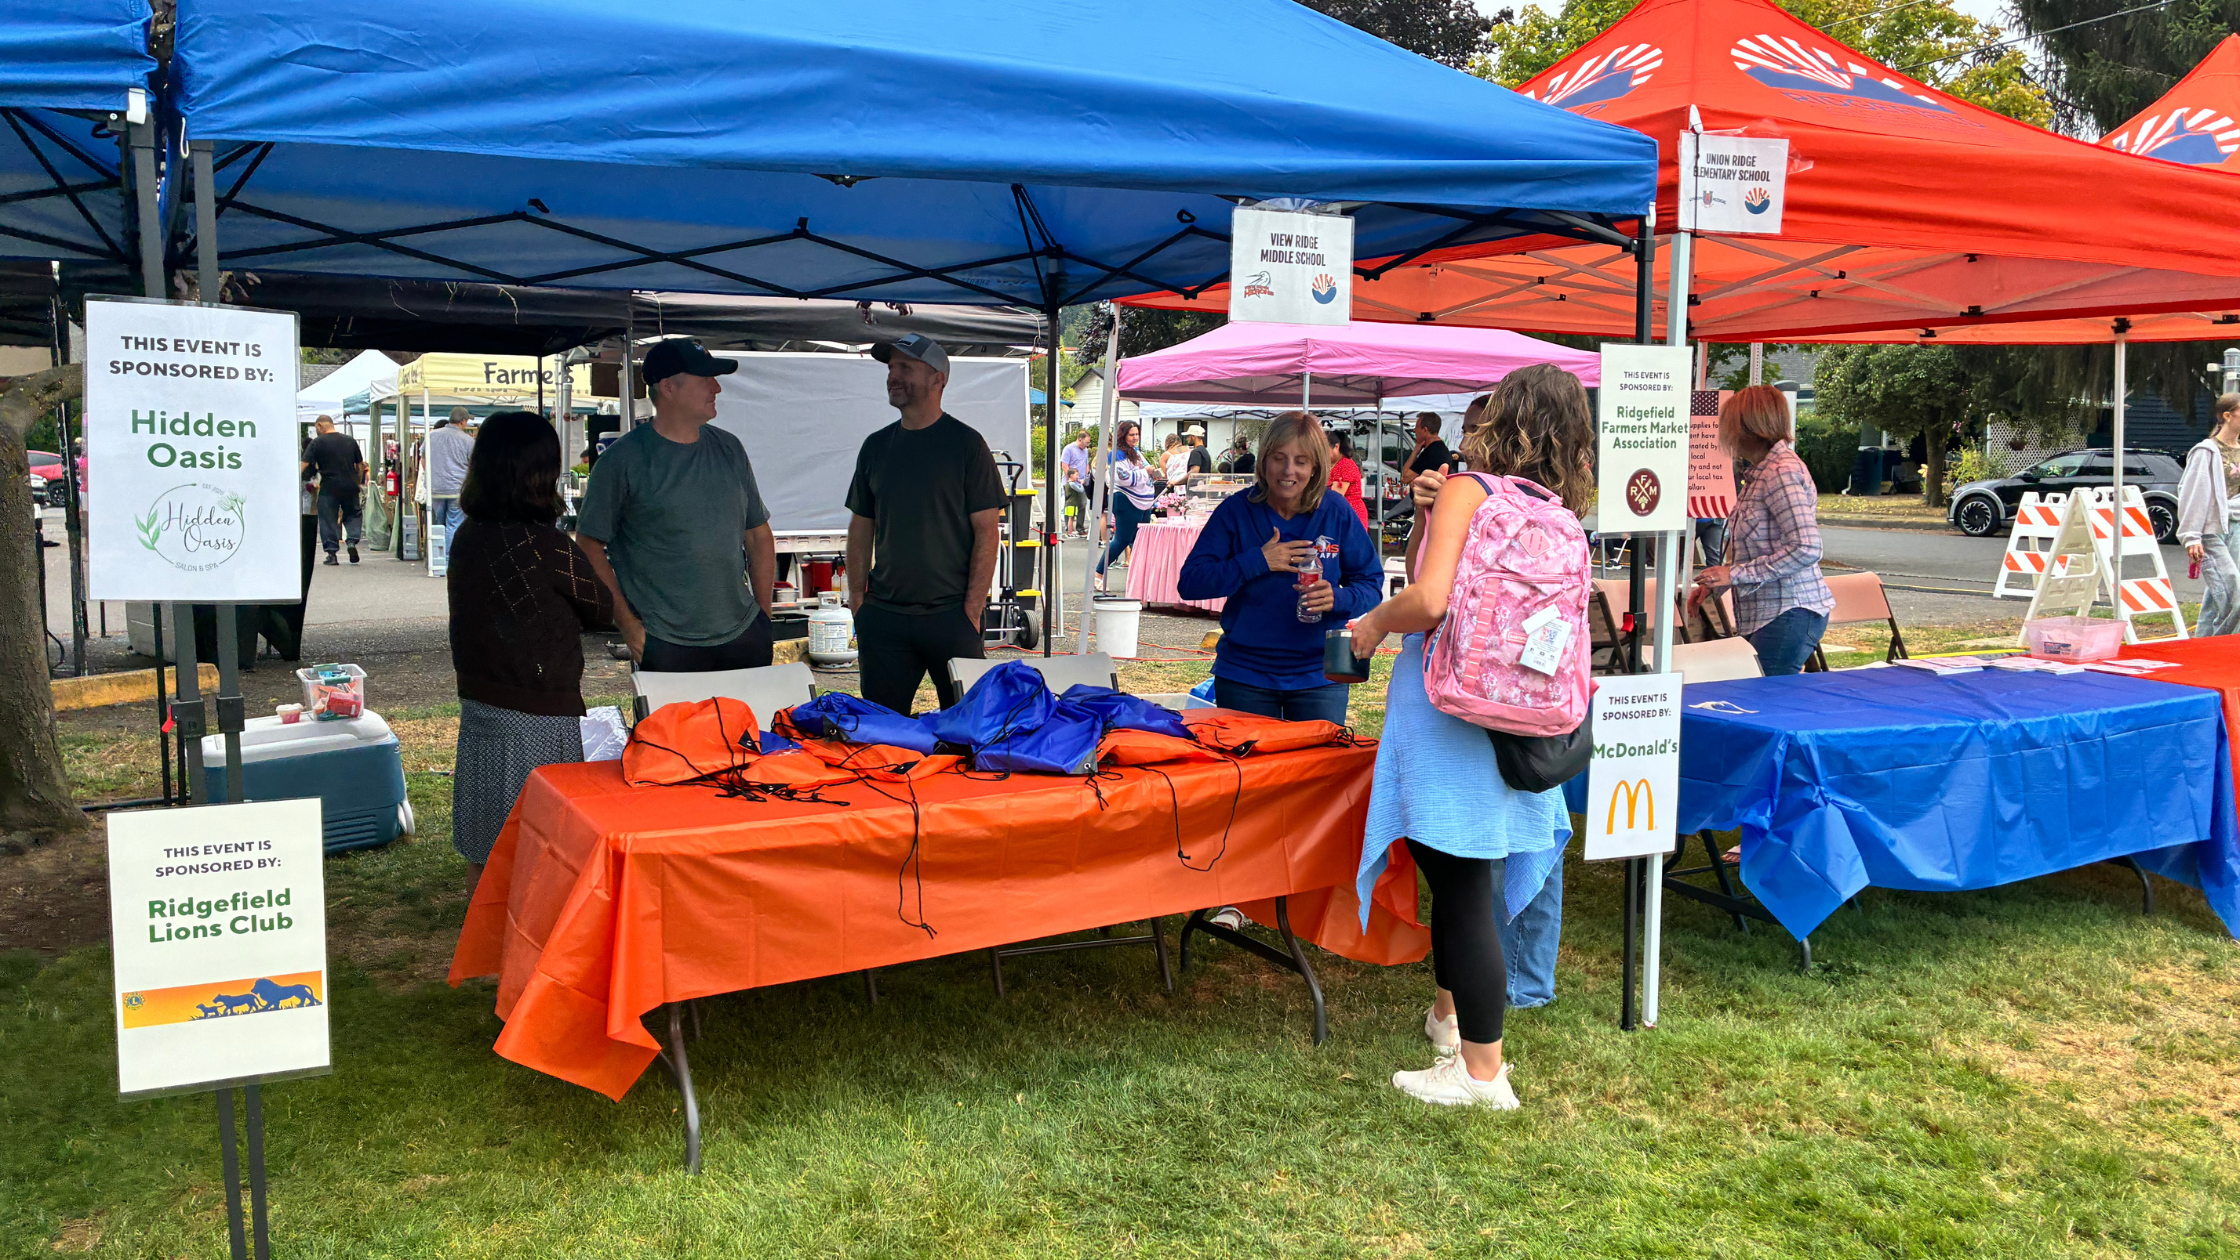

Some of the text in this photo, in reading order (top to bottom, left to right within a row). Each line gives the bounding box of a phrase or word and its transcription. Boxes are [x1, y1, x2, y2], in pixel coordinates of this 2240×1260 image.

[1707, 154, 1756, 167] UNION RIDGE
[1693, 166, 1771, 182] ELEMENTARY SCHOOL
[1271, 233, 1318, 249] VIEW RIDGE
[1261, 249, 1326, 266] MIDDLE SCHOOL
[121, 336, 262, 357] THIS EVENT IS
[110, 361, 274, 382] SPONSORED BY:
[1662, 384, 1674, 392] BY:
[1616, 406, 1675, 421] Ridgefield
[132, 410, 257, 438] Hidden
[1601, 422, 1689, 434] Farmers Market
[1690, 421, 1711, 430] upplies
[1613, 437, 1676, 448] Association
[1701, 431, 1715, 439] have
[1690, 441, 1718, 450] nated by
[147, 443, 243, 469] Oasis
[1690, 452, 1706, 460] local
[1698, 462, 1711, 470] and
[1696, 472, 1711, 480] local
[161, 501, 235, 531] Hidden
[184, 523, 236, 552] Oasis
[175, 561, 198, 571] SALON
[205, 562, 219, 571] SPA
[1609, 693, 1667, 704] THIS EVENT IS
[1602, 708, 1672, 721] SPONSORED BY:
[1591, 739, 1678, 759] McDonald's
[164, 840, 272, 858] THIS EVENT IS
[155, 857, 282, 878] SPONSORED BY:
[148, 888, 292, 919] Ridgefield
[149, 912, 293, 943] Lions Club
